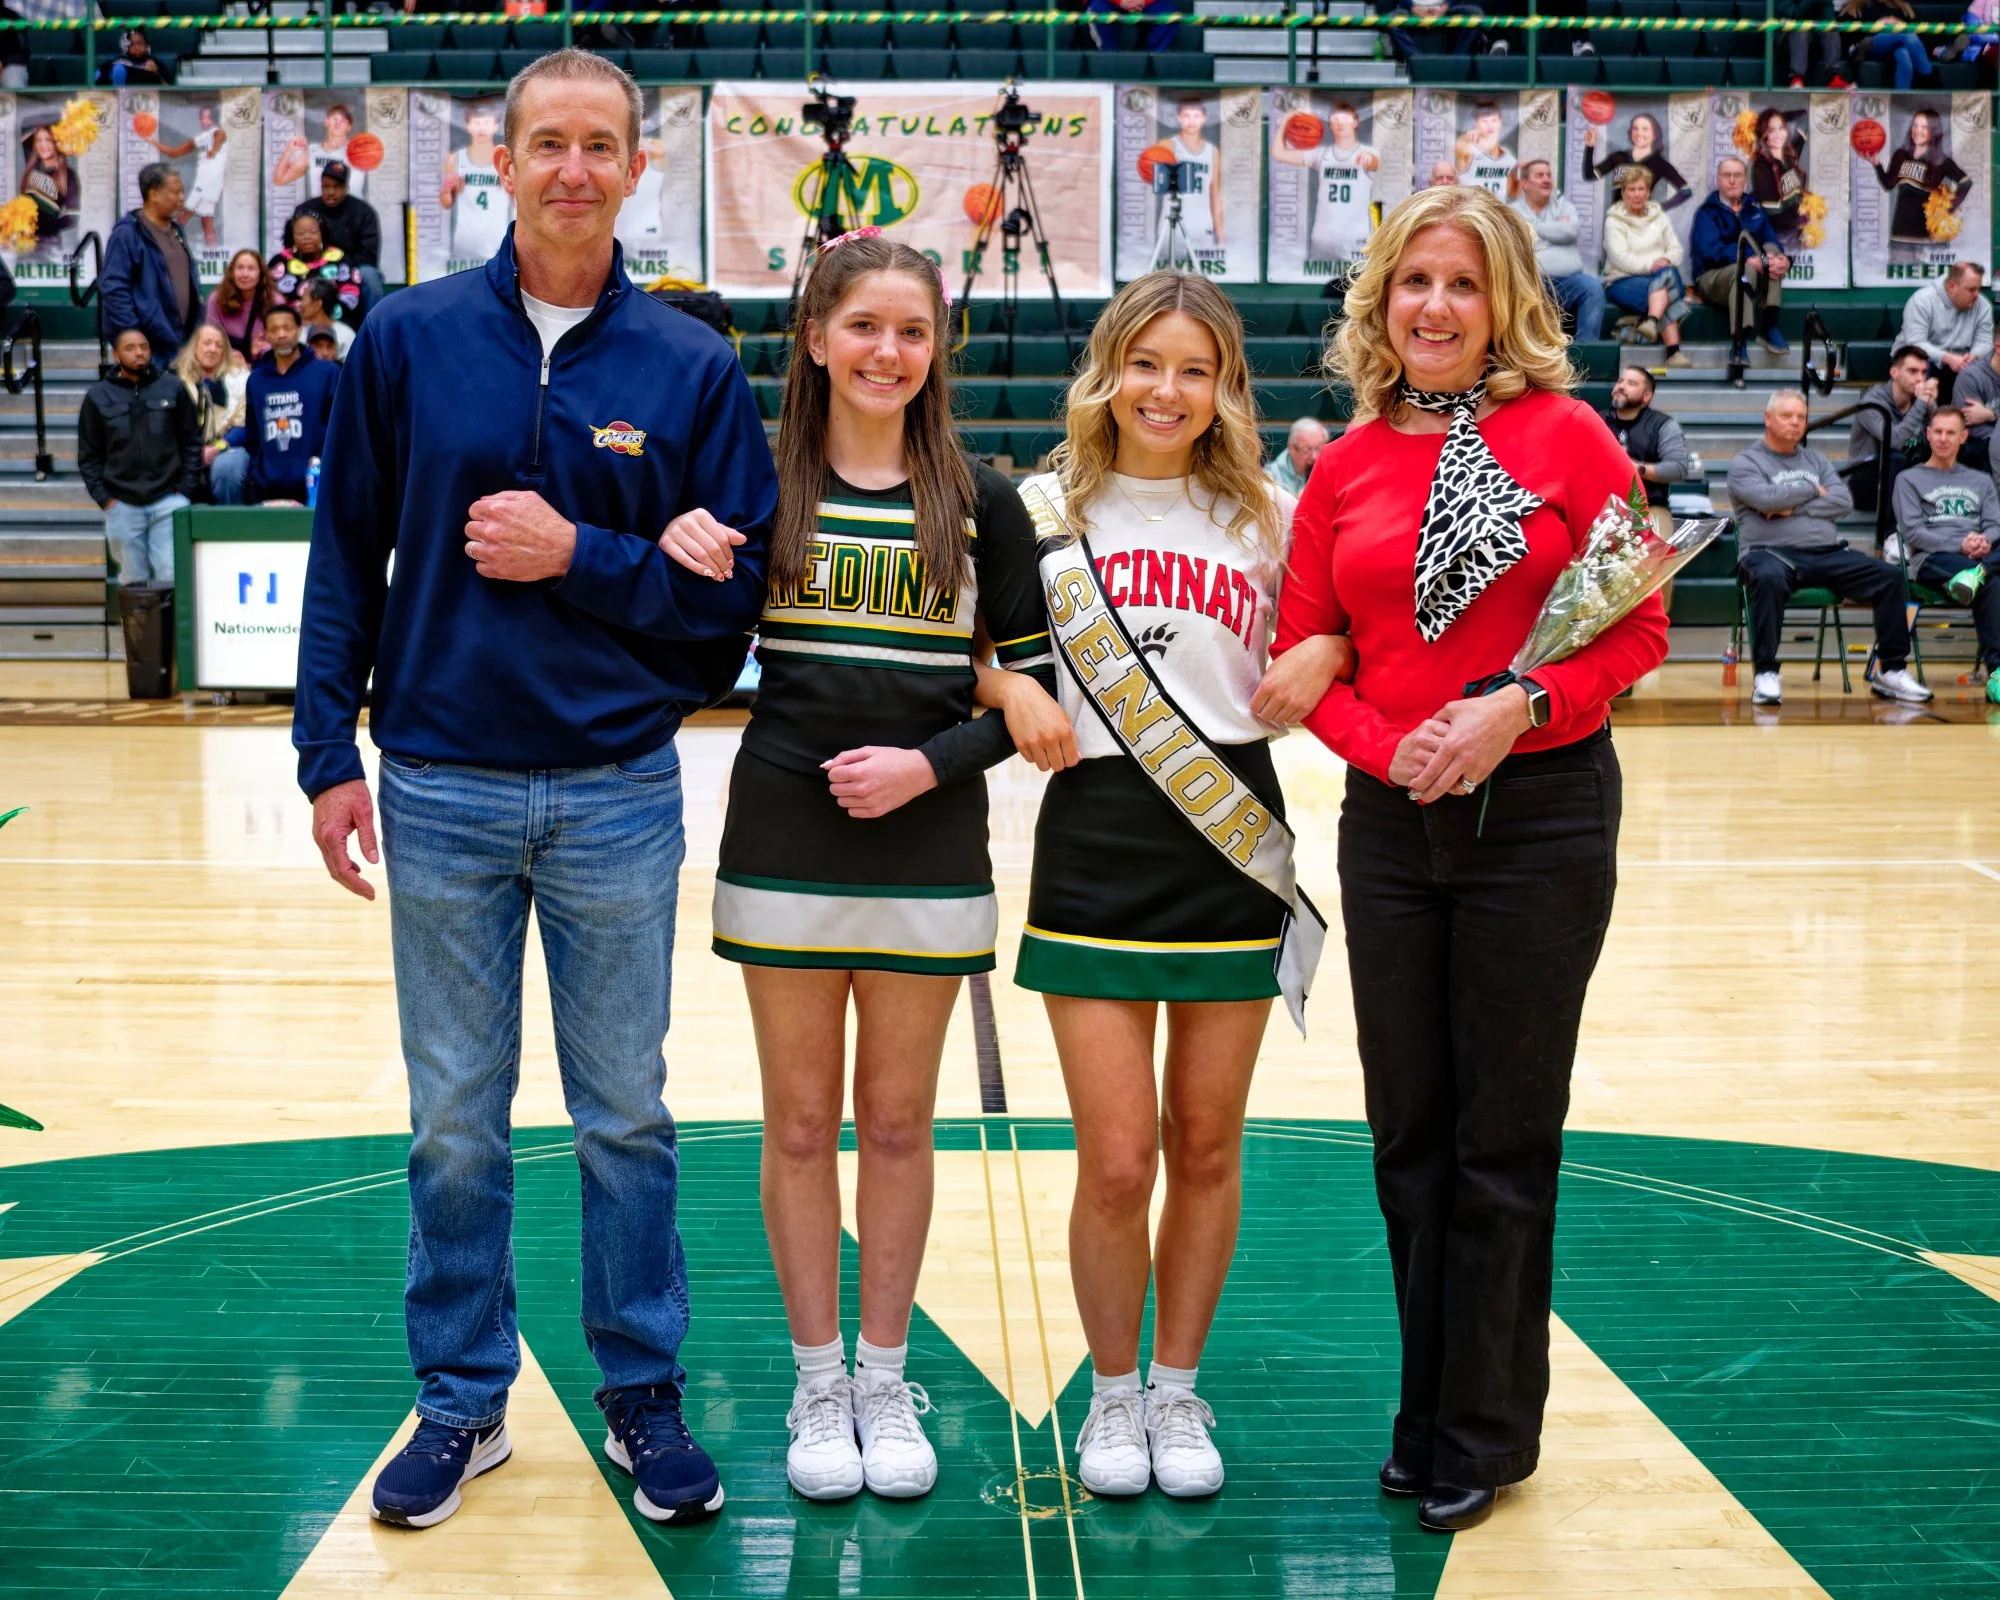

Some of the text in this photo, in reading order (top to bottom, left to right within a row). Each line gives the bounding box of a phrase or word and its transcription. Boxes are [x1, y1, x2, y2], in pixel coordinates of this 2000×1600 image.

[1324, 167, 1358, 180] MEDINA
[476, 191, 489, 210] 4
[1328, 184, 1351, 204] 20
[1930, 253, 1956, 263] AVERY
[268, 391, 299, 405] TITANS
[214, 621, 300, 634] Nationwide
[1047, 566, 1271, 867] SENIOR
